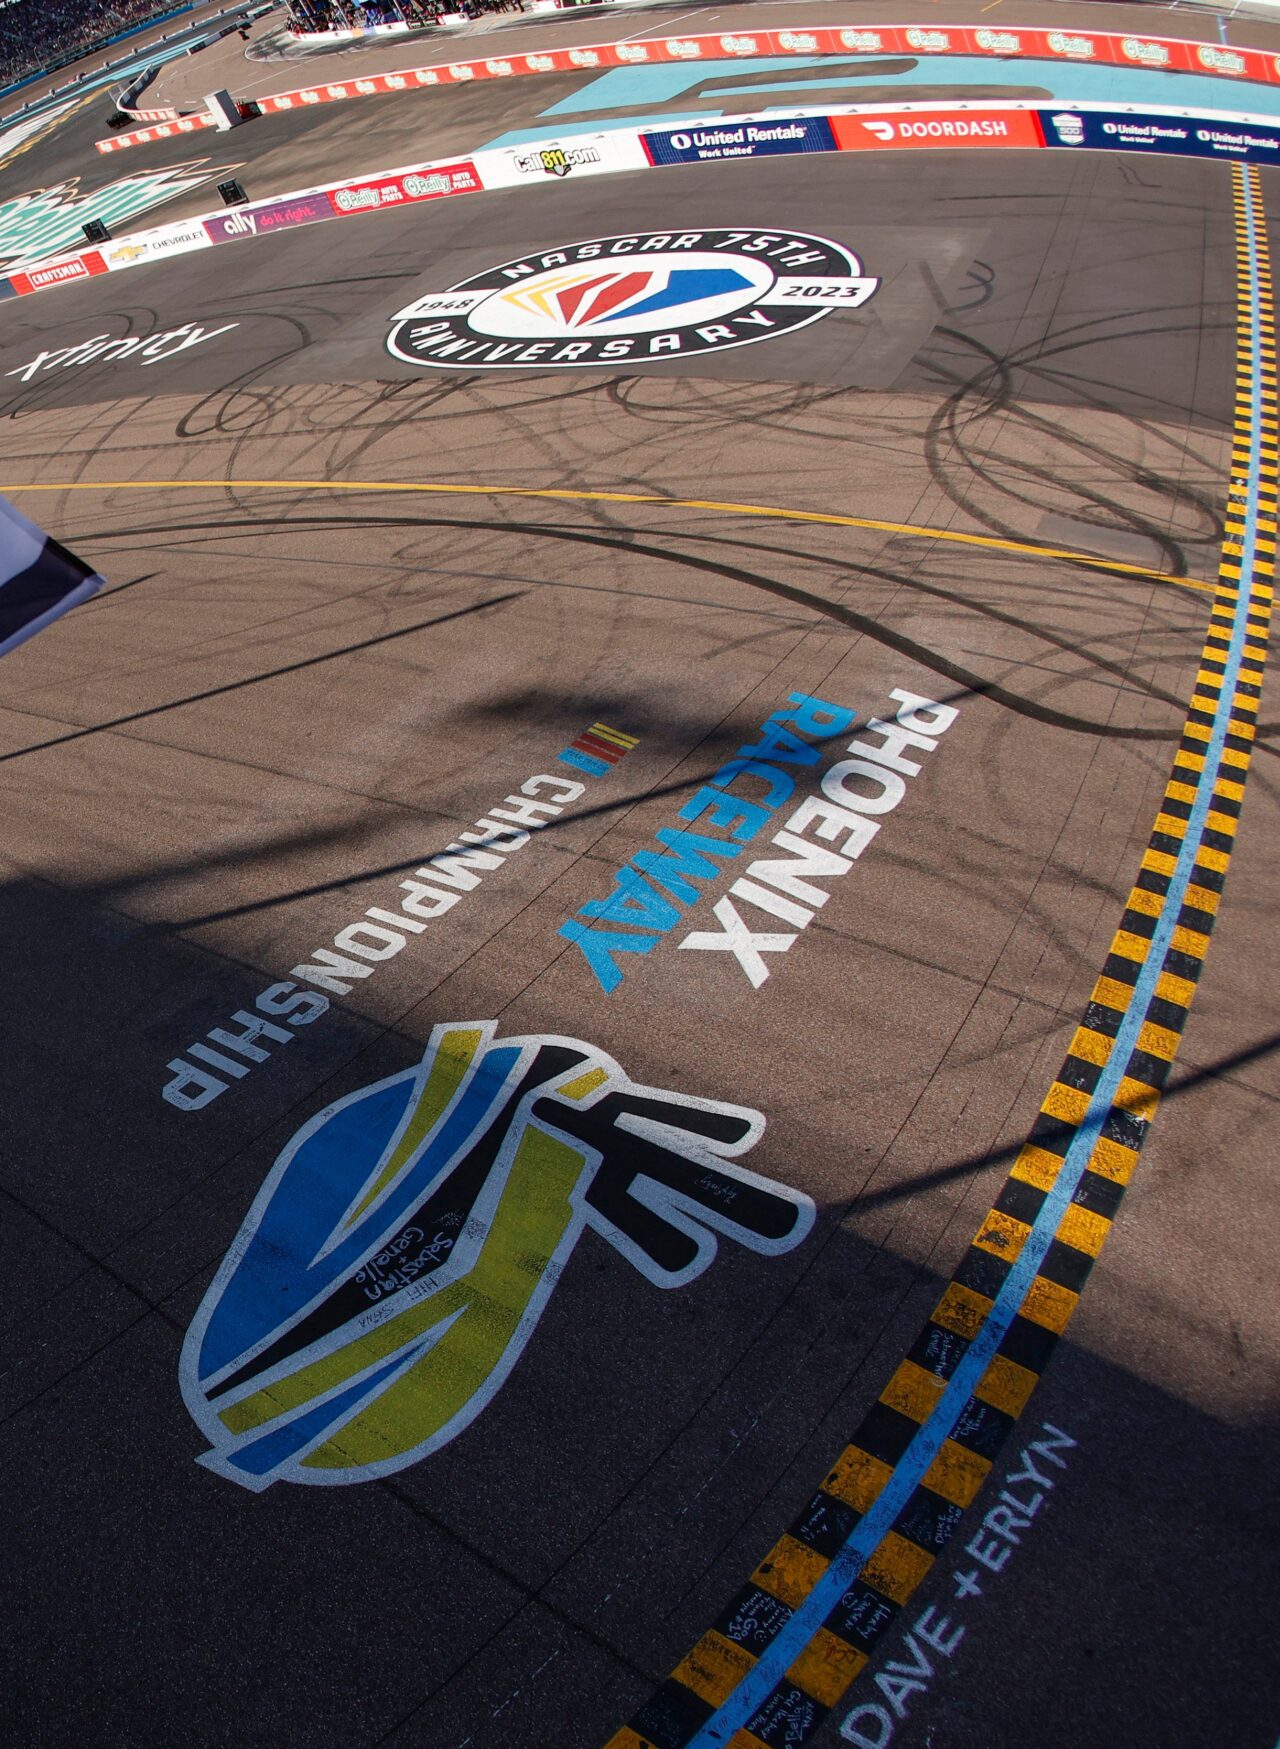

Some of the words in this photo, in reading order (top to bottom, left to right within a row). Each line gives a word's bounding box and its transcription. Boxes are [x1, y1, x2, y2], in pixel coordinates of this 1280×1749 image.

[692, 127, 745, 149] United
[746, 125, 804, 145] Rentals
[899, 120, 1008, 138] DOORDASH
[1117, 123, 1149, 137] United
[1151, 127, 1187, 139] Rentals
[1212, 131, 1240, 146] United
[1242, 134, 1280, 149] Rentals
[514, 146, 601, 174] Call811.com
[698, 147, 720, 159] Work
[722, 145, 753, 156] United
[452, 171, 471, 182] AUTO
[453, 178, 476, 190] PARTS
[381, 185, 398, 196] AUTO
[382, 191, 403, 202] PARTS
[223, 213, 257, 235] ally
[260, 213, 273, 226] do
[152, 230, 205, 250] CHEVROLET
[501, 232, 703, 281] NASCAR
[712, 231, 827, 269] 75TH
[782, 284, 859, 299] 2023
[416, 296, 477, 312] 1948
[409, 309, 780, 363] ANNIVERSARY
[557, 690, 857, 997] RACEWAY
[677, 687, 961, 990] PHOENIX
[161, 773, 588, 1113] CHAMPIONSHIP
[355, 1226, 424, 1283] Genelle
[363, 1231, 453, 1301] Sebastian
[838, 1603, 968, 1749] DAVE
[966, 1421, 1078, 1575] ERLYN
